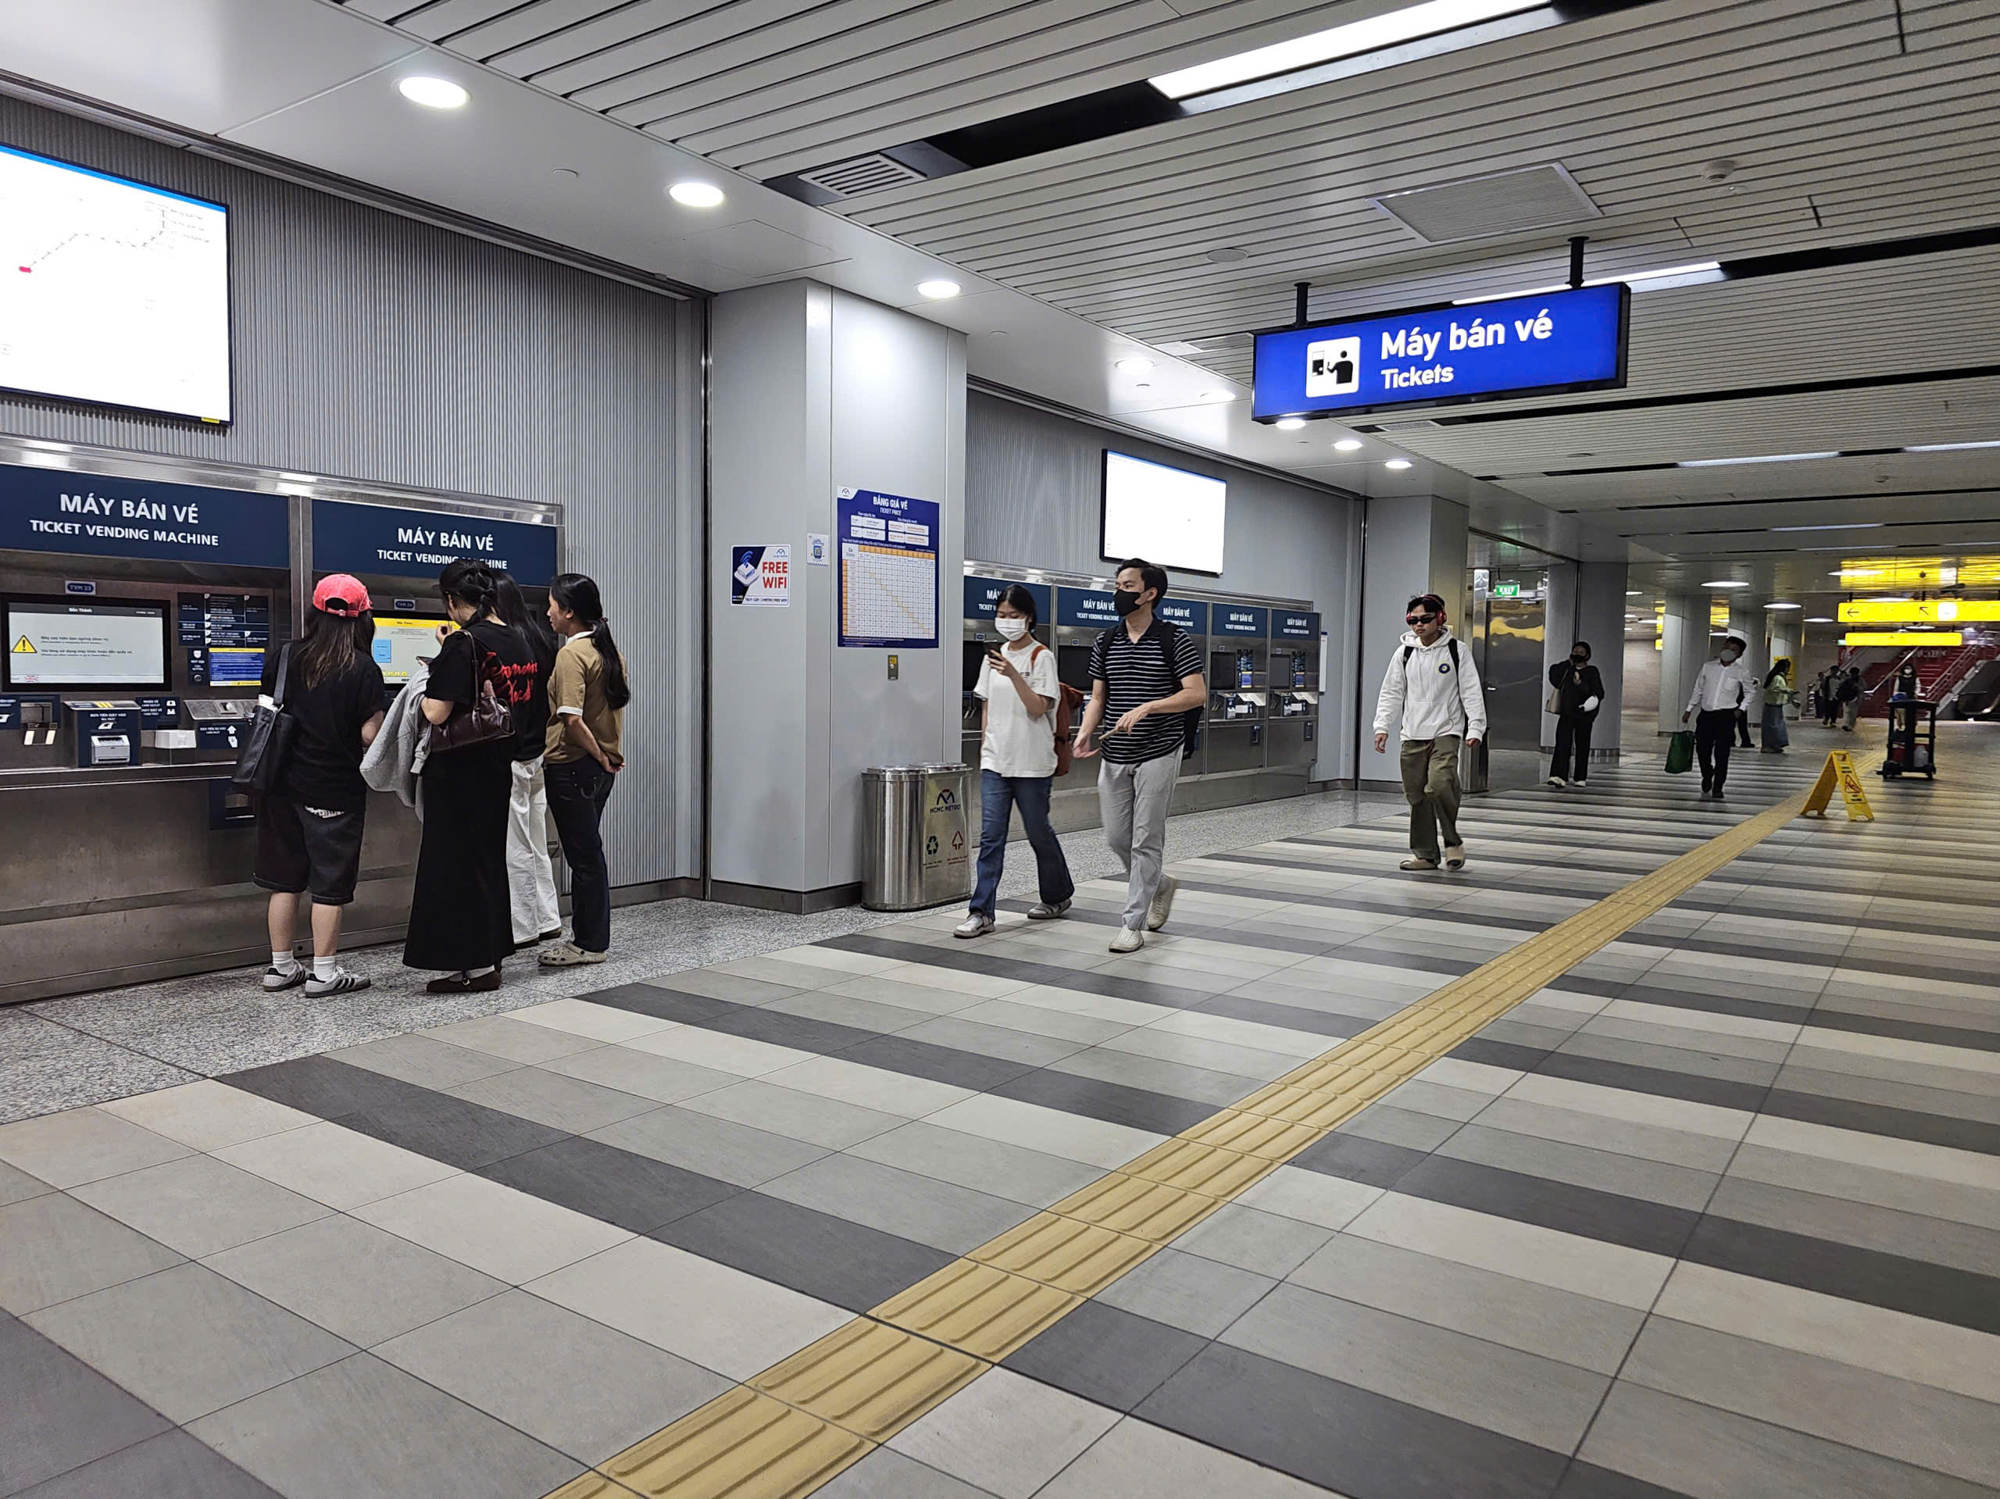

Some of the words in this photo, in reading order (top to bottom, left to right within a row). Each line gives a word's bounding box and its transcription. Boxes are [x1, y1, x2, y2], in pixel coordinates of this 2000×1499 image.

[1381, 326, 1441, 362] Máy
[1449, 318, 1505, 351] bán
[1514, 309, 1553, 342] vé
[1381, 364, 1454, 390] Tickets
[60, 492, 115, 516] MÁY
[122, 498, 166, 522] BÁN
[173, 503, 199, 524] VÉ
[890, 499, 900, 509] GIÁ
[900, 500, 908, 510] VÉ
[29, 519, 81, 535] TICKET
[85, 524, 150, 541] VENDING
[153, 530, 219, 546] MACHINE
[397, 526, 435, 545] MÁY
[440, 530, 471, 549] BÁN
[475, 534, 494, 551] VÉ
[377, 550, 412, 561] TICKET
[762, 562, 788, 574] FREE
[762, 577, 786, 588] WIFI
[1083, 598, 1096, 609] MÁY
[1096, 600, 1108, 610] BÁN
[1108, 601, 1115, 611] VÉ
[1163, 606, 1174, 616] MÁY
[1174, 607, 1184, 617] BÁN
